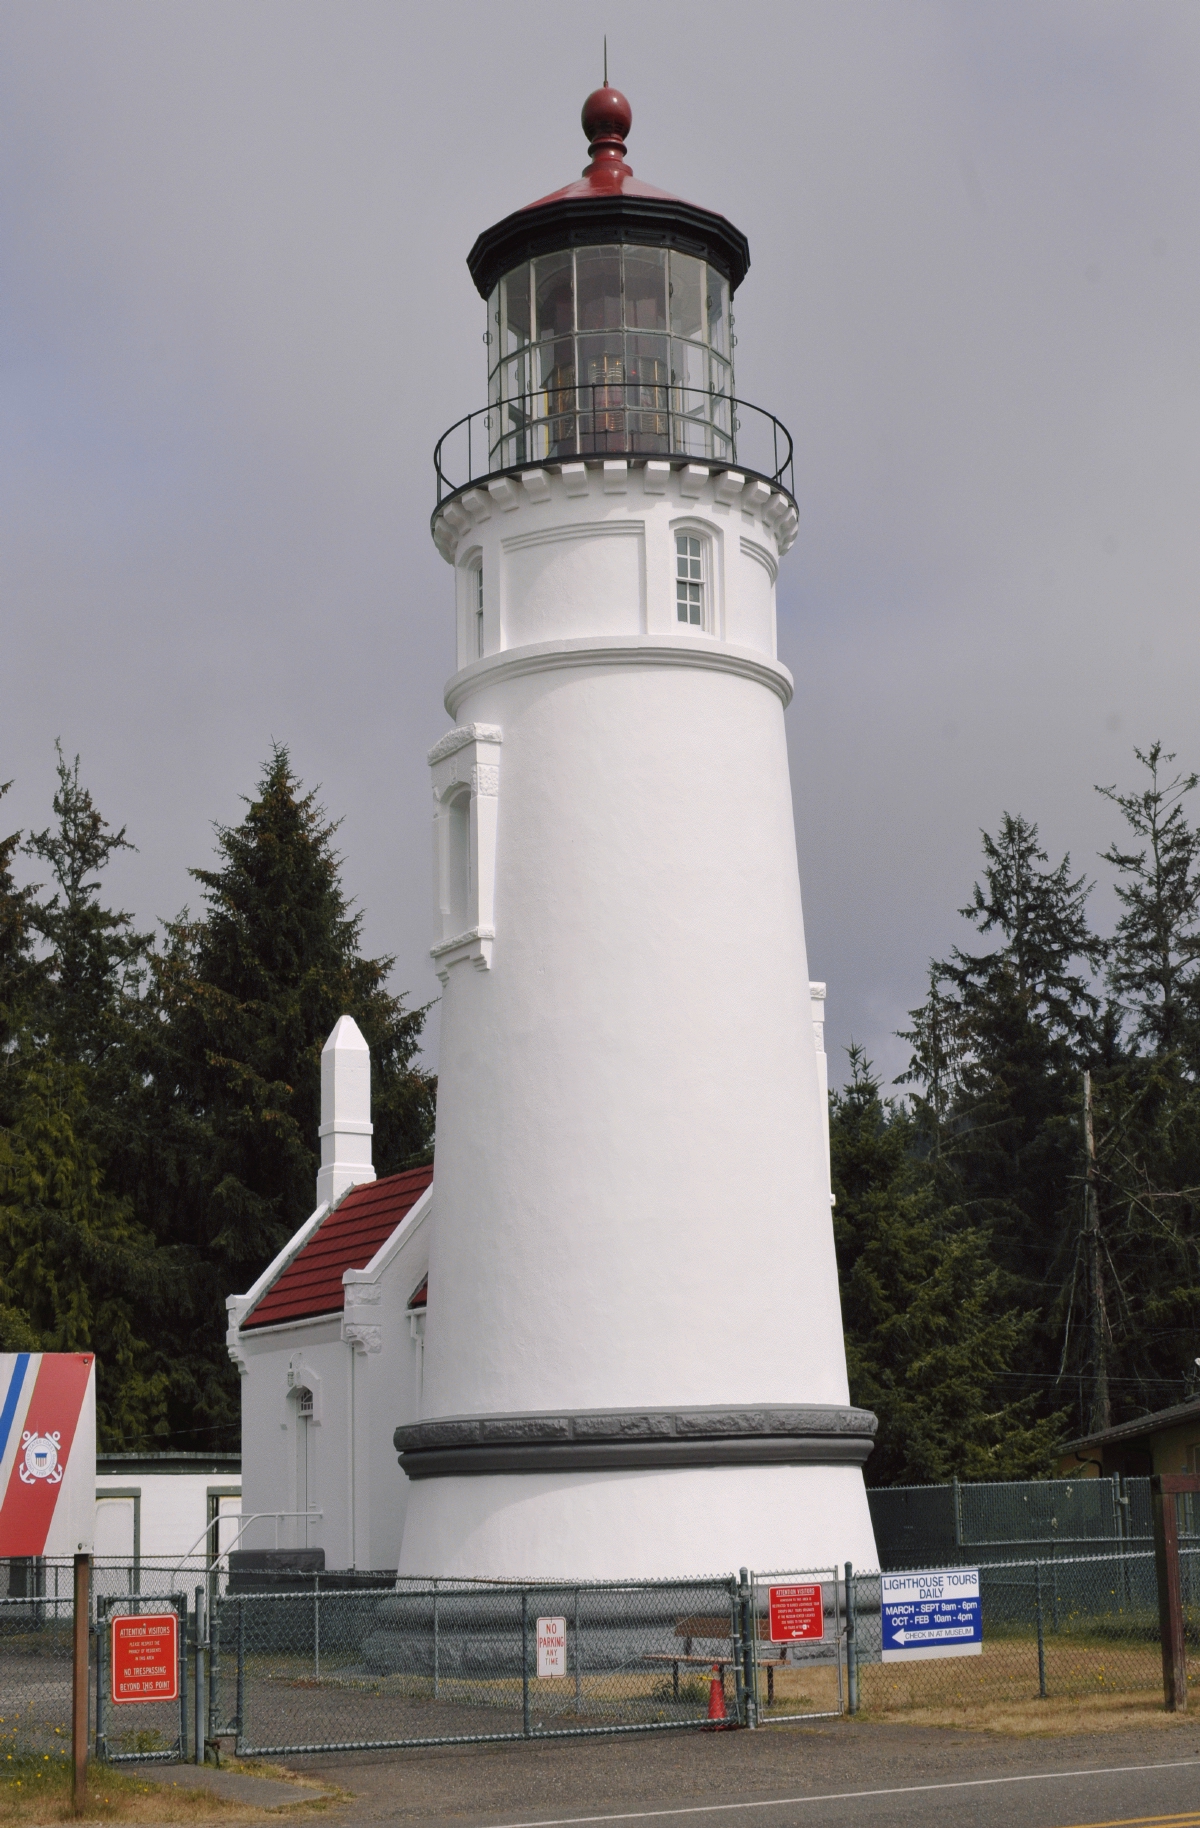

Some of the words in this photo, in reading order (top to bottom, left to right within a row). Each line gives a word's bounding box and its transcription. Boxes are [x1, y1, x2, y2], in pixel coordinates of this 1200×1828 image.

[884, 1576, 944, 1590] LIGHTHOUSE
[947, 1574, 977, 1586] TOURS
[776, 1589, 796, 1597] ATTENTION
[919, 1588, 944, 1599] DAILY
[886, 1605, 914, 1615] MARCH
[920, 1603, 939, 1612] SEPT
[941, 1603, 956, 1611] 9am
[962, 1601, 977, 1611] 6pm
[891, 1617, 908, 1626] OCT
[914, 1615, 929, 1624] FEB
[934, 1614, 951, 1623] 10am
[957, 1613, 973, 1622] 4pm
[120, 1628, 146, 1636] ATTENTION
[148, 1627, 170, 1635] VISITORS
[546, 1623, 556, 1634] NO
[905, 1631, 926, 1639] CHECK
[944, 1628, 972, 1636] MUSEUM
[539, 1637, 564, 1648] PARKING
[546, 1649, 557, 1657] ANY
[123, 1668, 131, 1676] NO
[133, 1666, 166, 1675] TRESPASSING
[120, 1682, 140, 1691] BEYOND
[142, 1681, 153, 1690] THIS
[155, 1681, 170, 1689] POINT
